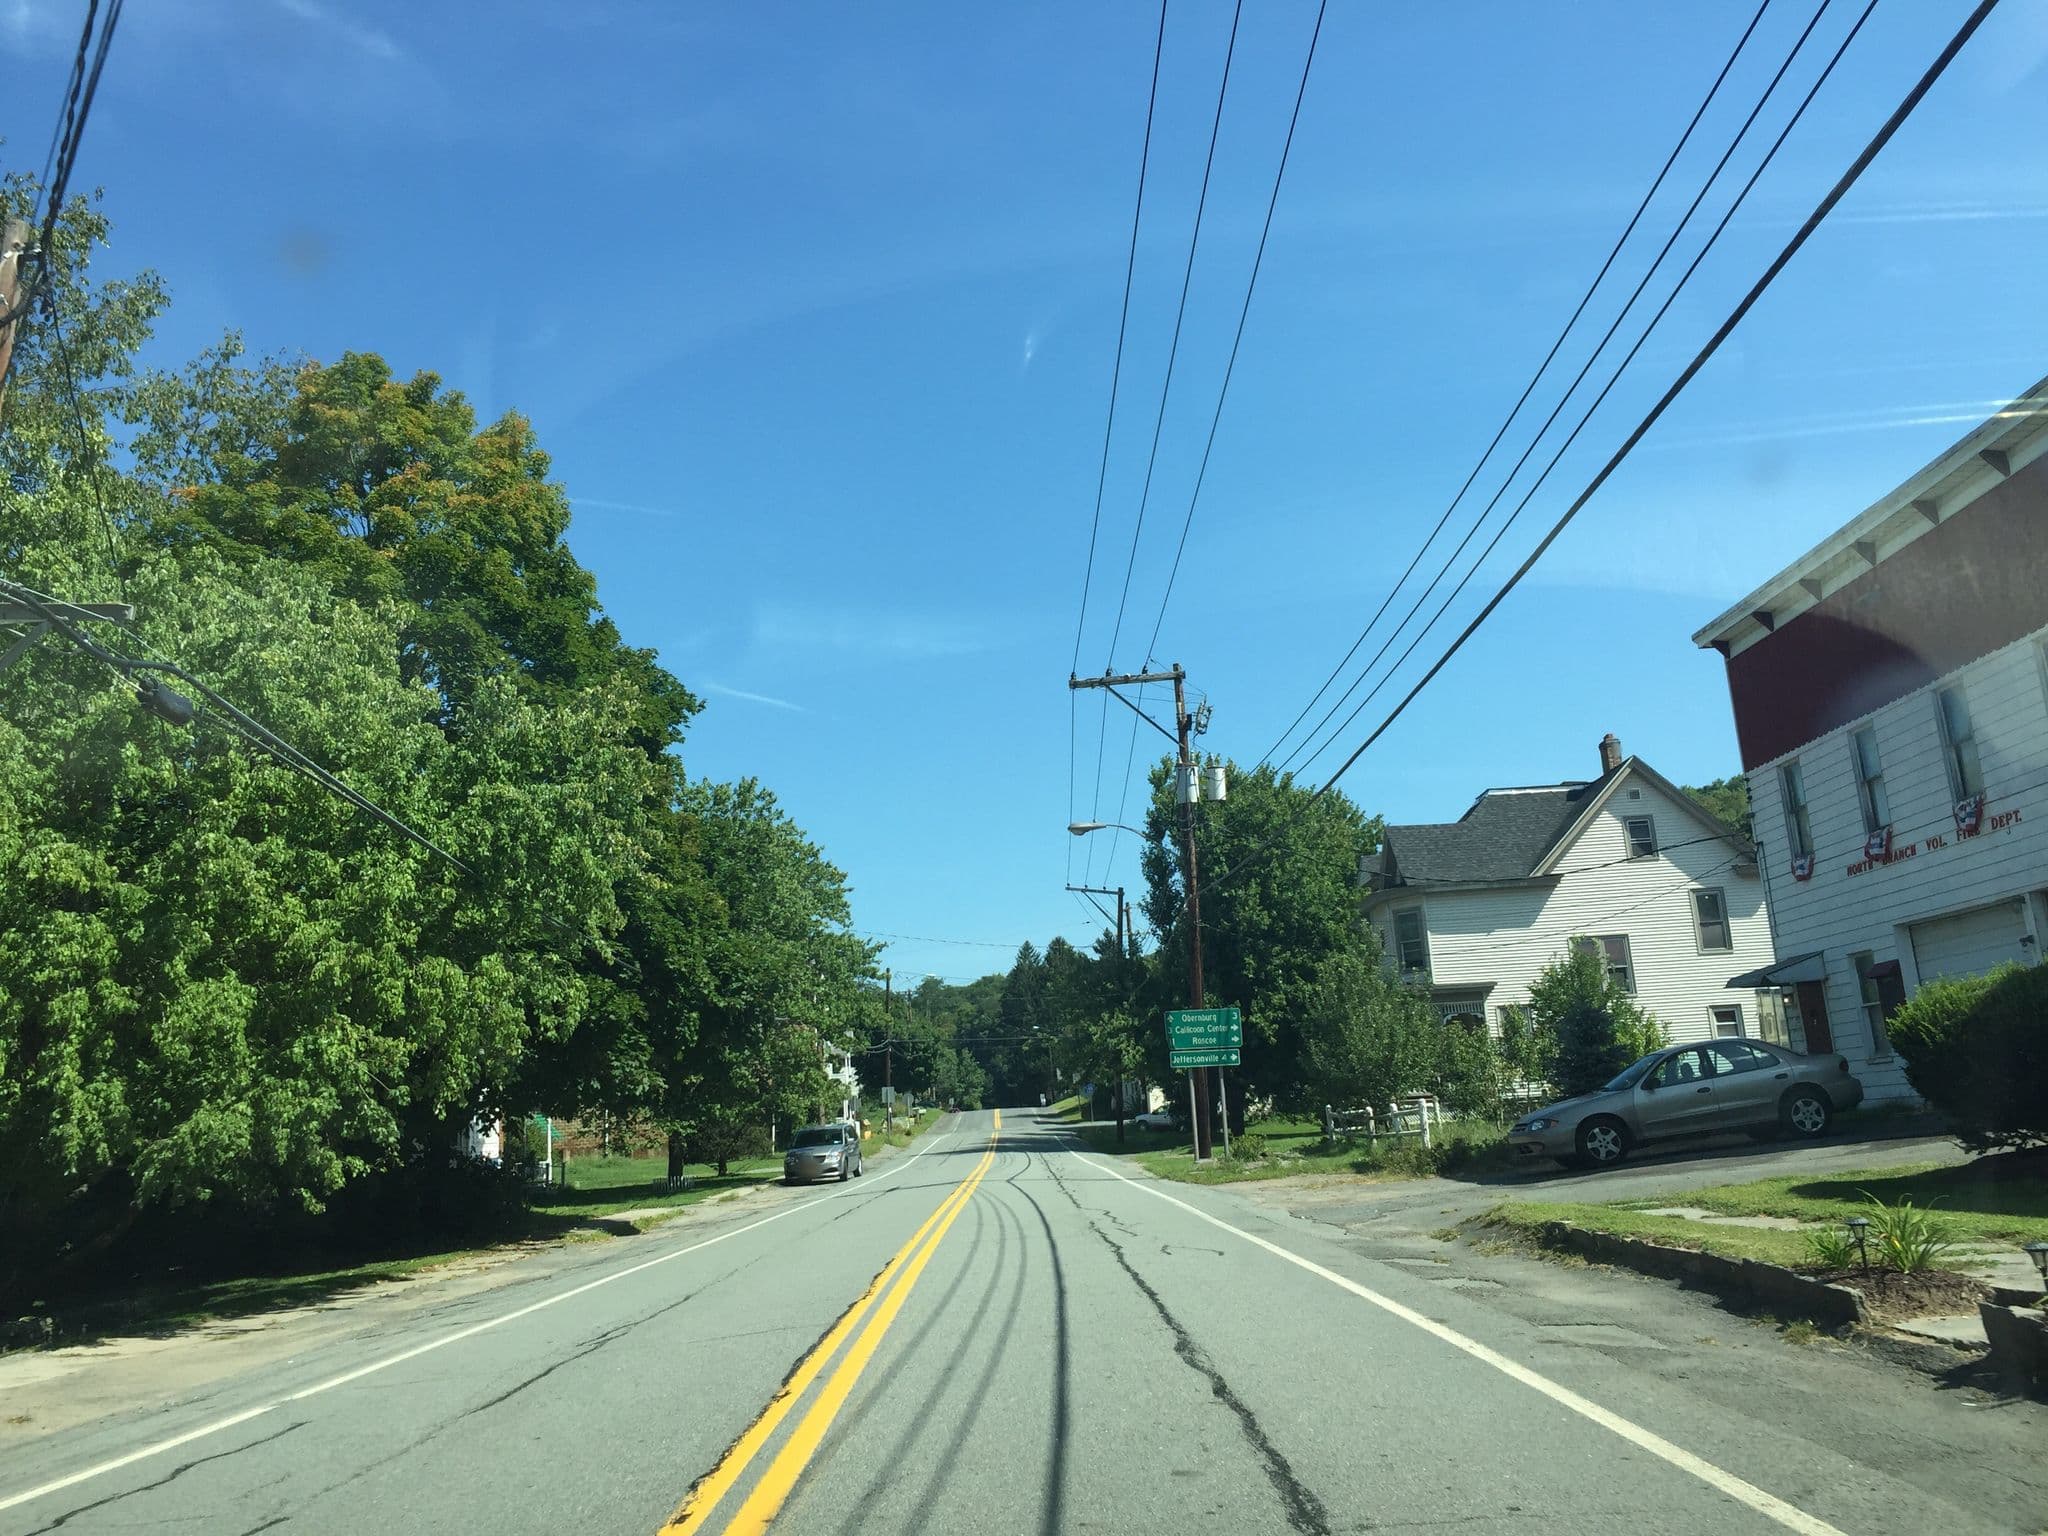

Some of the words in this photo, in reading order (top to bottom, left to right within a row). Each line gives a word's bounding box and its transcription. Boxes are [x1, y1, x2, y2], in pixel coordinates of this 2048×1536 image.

[1847, 860, 1874, 877] NORTH
[1991, 810, 2022, 830] DEPT.
[1181, 1013, 1217, 1023] Obernburg
[1232, 1012, 1238, 1020] 3
[1175, 1025, 1205, 1034] Callicoon
[1207, 1024, 1228, 1032] Center
[1192, 1037, 1217, 1045] Roscoe
[1173, 1054, 1219, 1064] Jeffersonville
